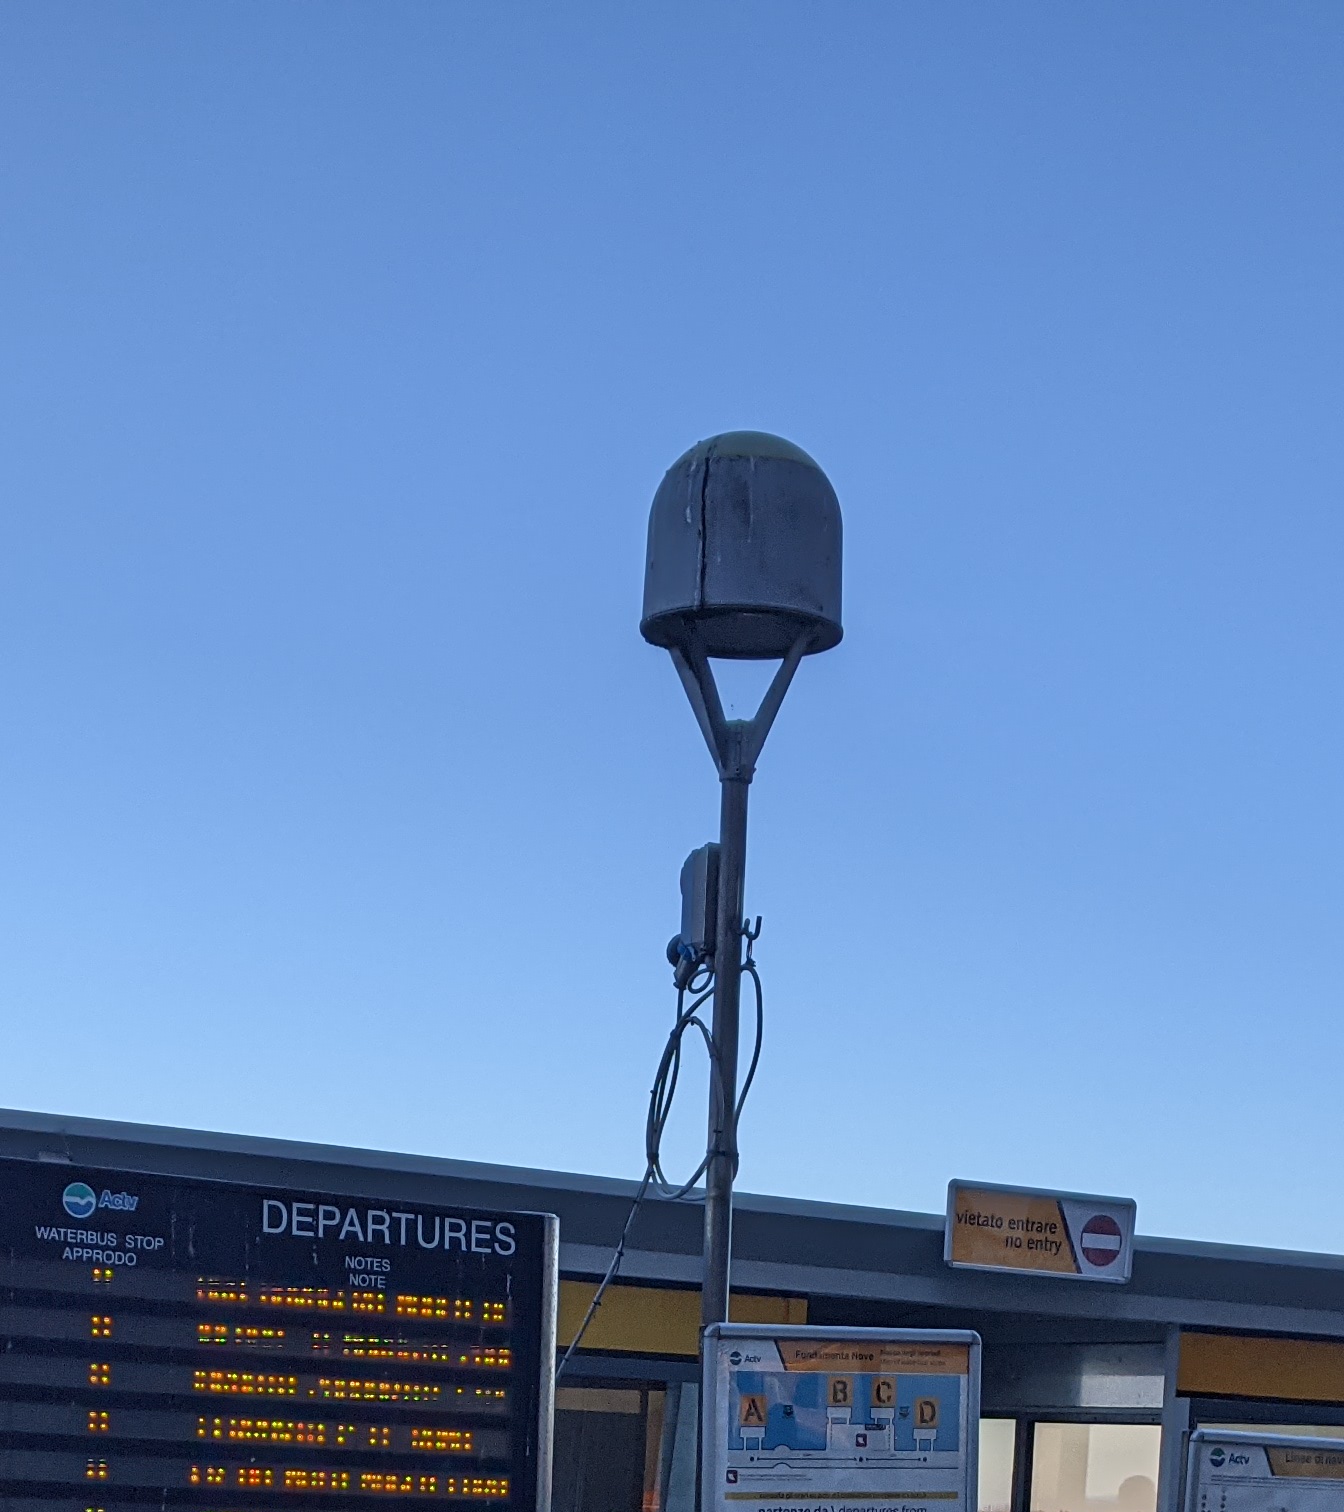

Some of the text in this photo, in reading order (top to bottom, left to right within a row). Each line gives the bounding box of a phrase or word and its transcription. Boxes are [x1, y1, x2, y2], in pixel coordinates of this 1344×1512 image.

[98, 1189, 139, 1211] Actv
[262, 1199, 516, 1256] DEPARTURES
[957, 1210, 1058, 1234] vietato entrare
[35, 1225, 165, 1252] WATERBUS STOP
[1005, 1235, 1062, 1256] no entry
[62, 1247, 137, 1267] APPRODO
[345, 1256, 391, 1273] NOTES
[349, 1273, 387, 1289] NOTE
[832, 1380, 849, 1403] B
[876, 1381, 892, 1402] C
[743, 1398, 764, 1422] A
[919, 1401, 936, 1424] D
[1228, 1453, 1250, 1465] Actv
